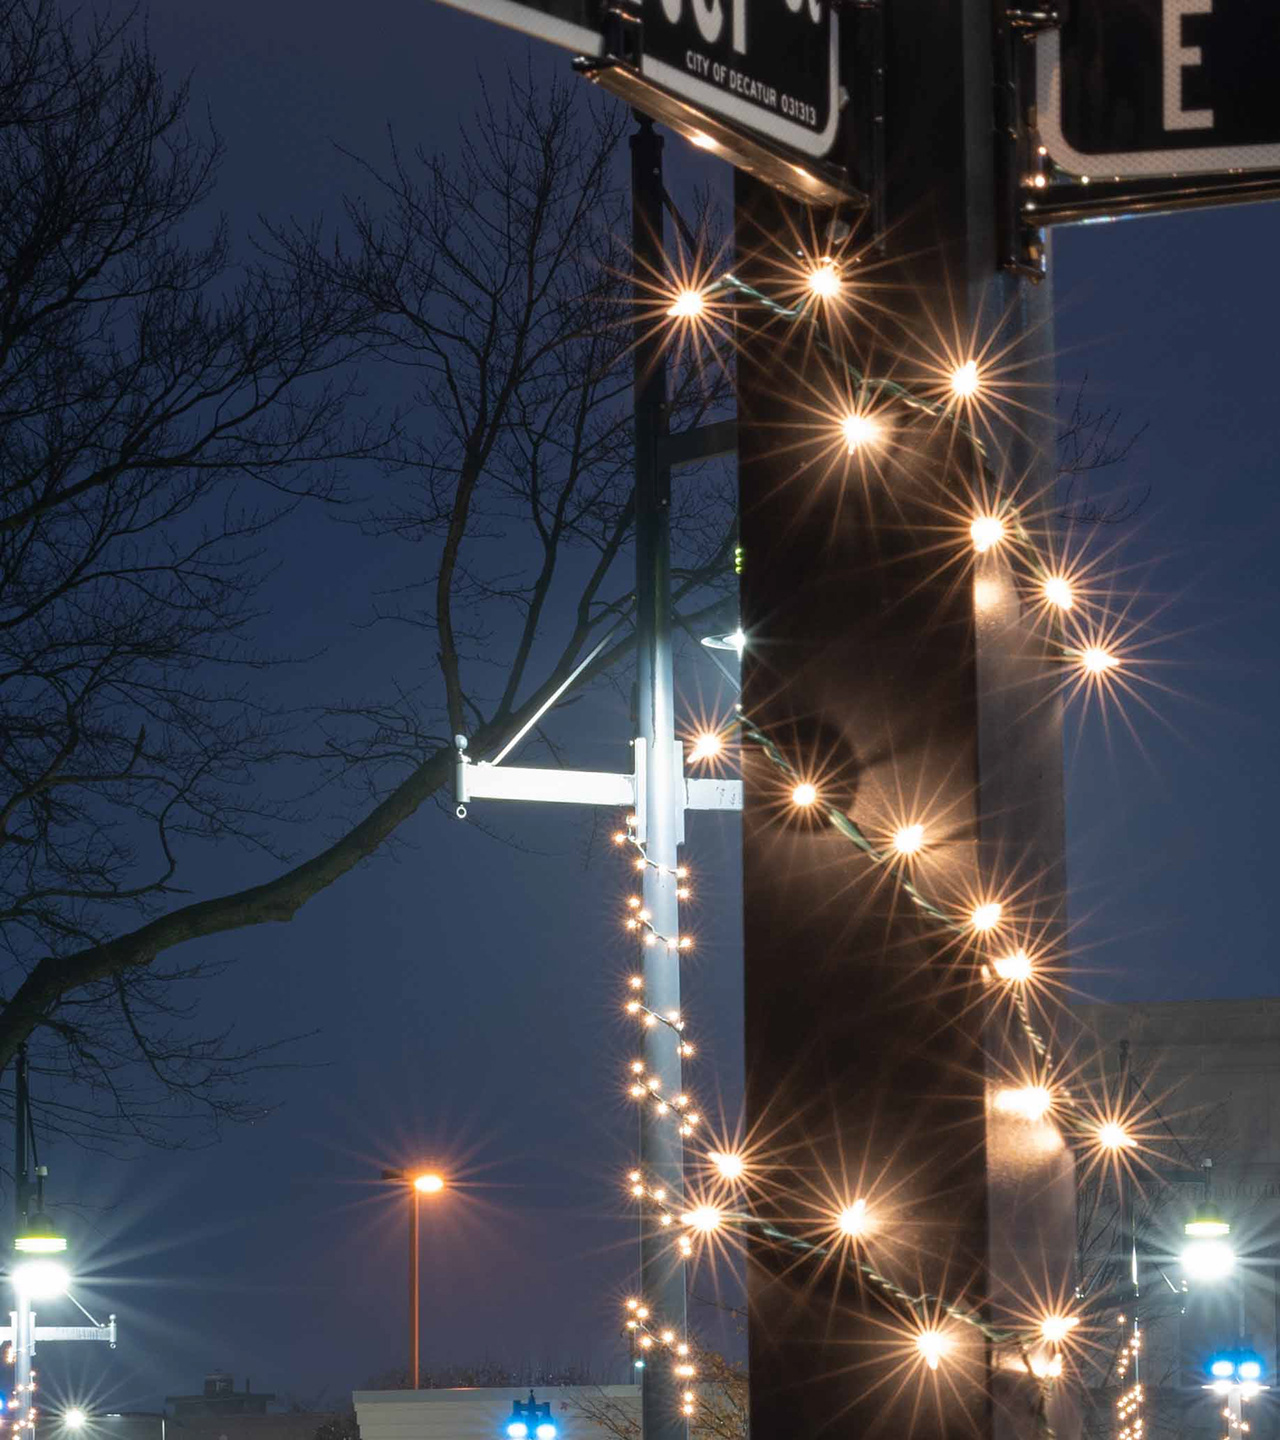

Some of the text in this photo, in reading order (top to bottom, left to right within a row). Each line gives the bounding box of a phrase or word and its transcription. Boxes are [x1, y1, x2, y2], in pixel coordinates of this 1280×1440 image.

[685, 49, 817, 127] CITY OF DECATUR 031313
